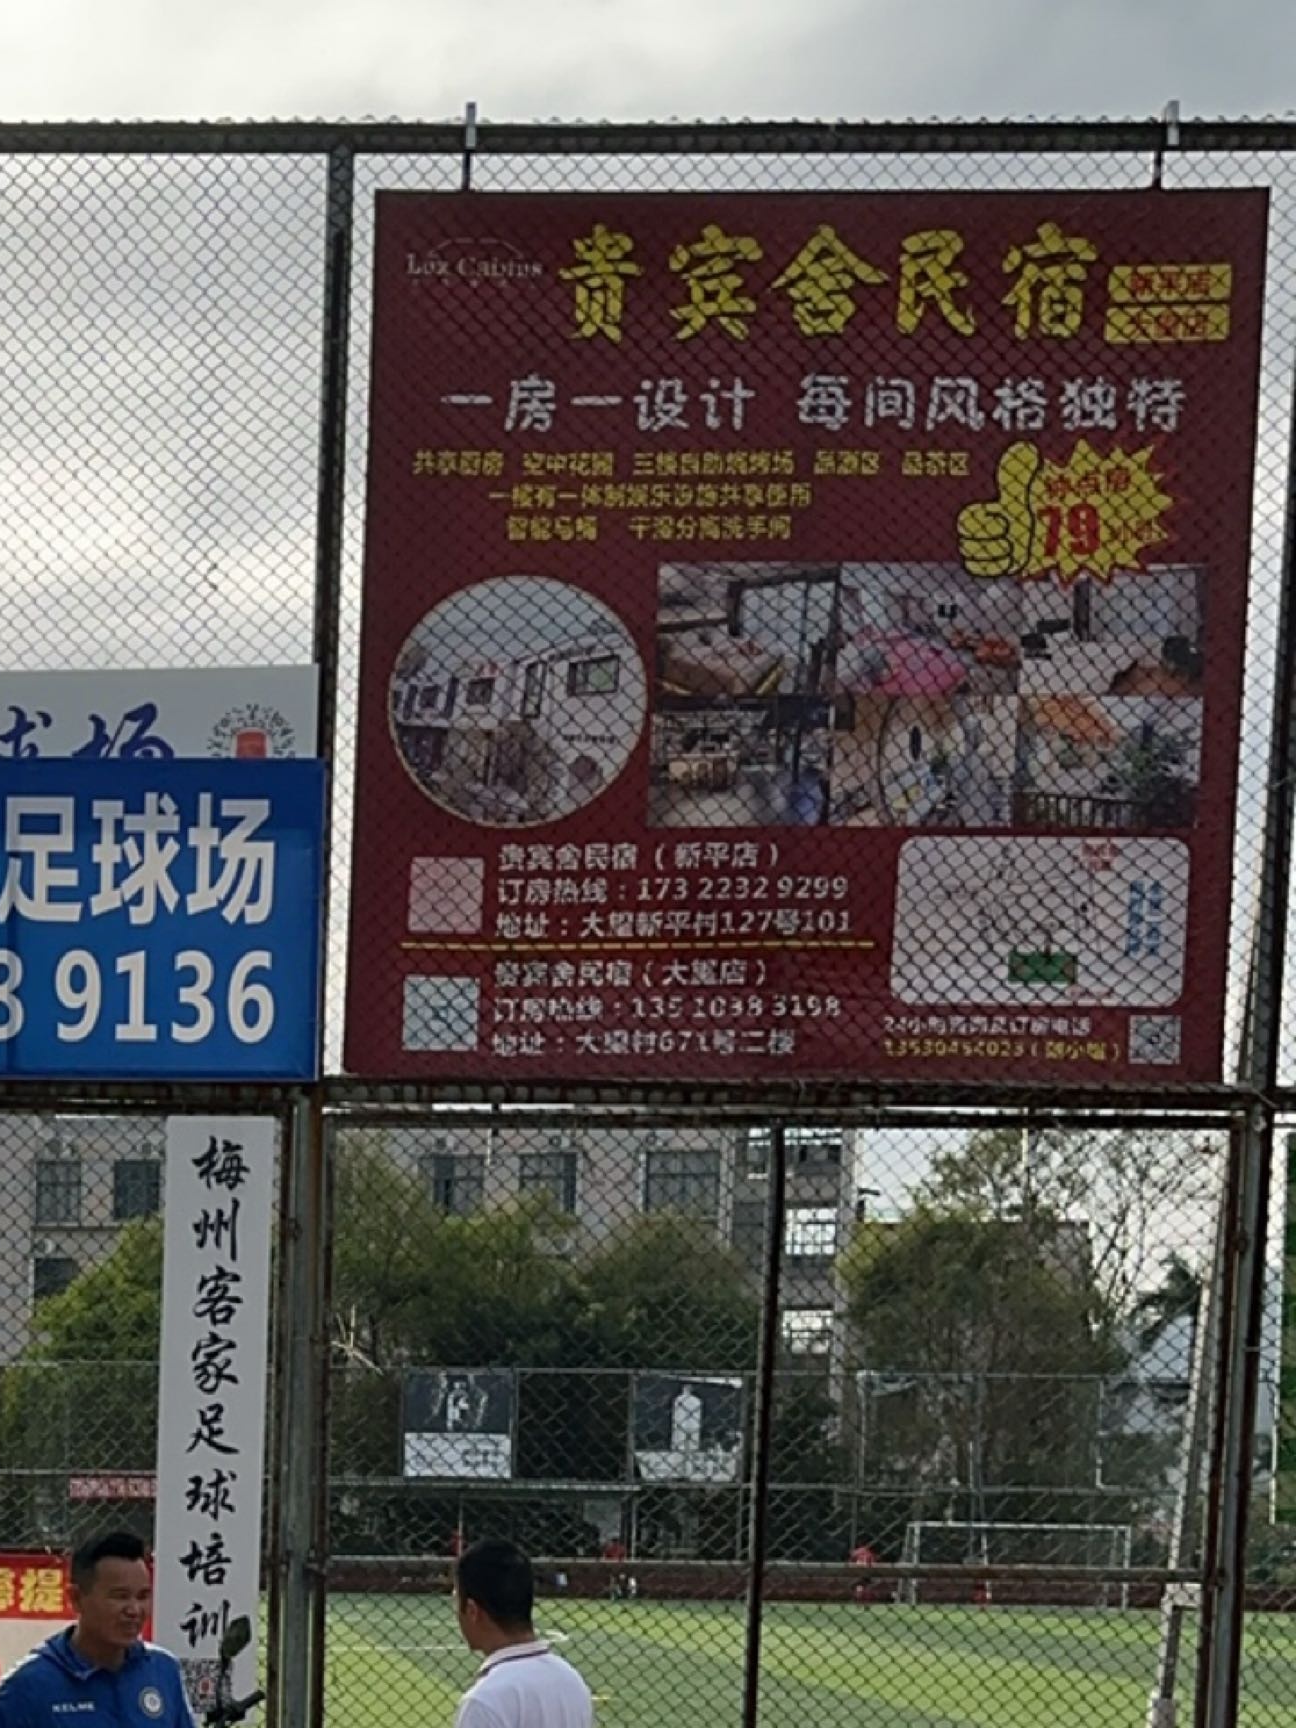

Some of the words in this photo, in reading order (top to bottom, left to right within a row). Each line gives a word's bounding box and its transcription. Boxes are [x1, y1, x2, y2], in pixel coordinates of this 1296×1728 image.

[558, 223, 1101, 341] 贵宾舍民宿
[441, 374, 754, 432] 一房一设计
[796, 372, 1185, 433] 每间风格独特
[1036, 503, 1100, 557] 79
[698, 876, 769, 899] 2232
[777, 875, 849, 899] 9299
[54, 948, 276, 1044] 9136
[179, 1134, 250, 1651] 梅州客家足球培训
